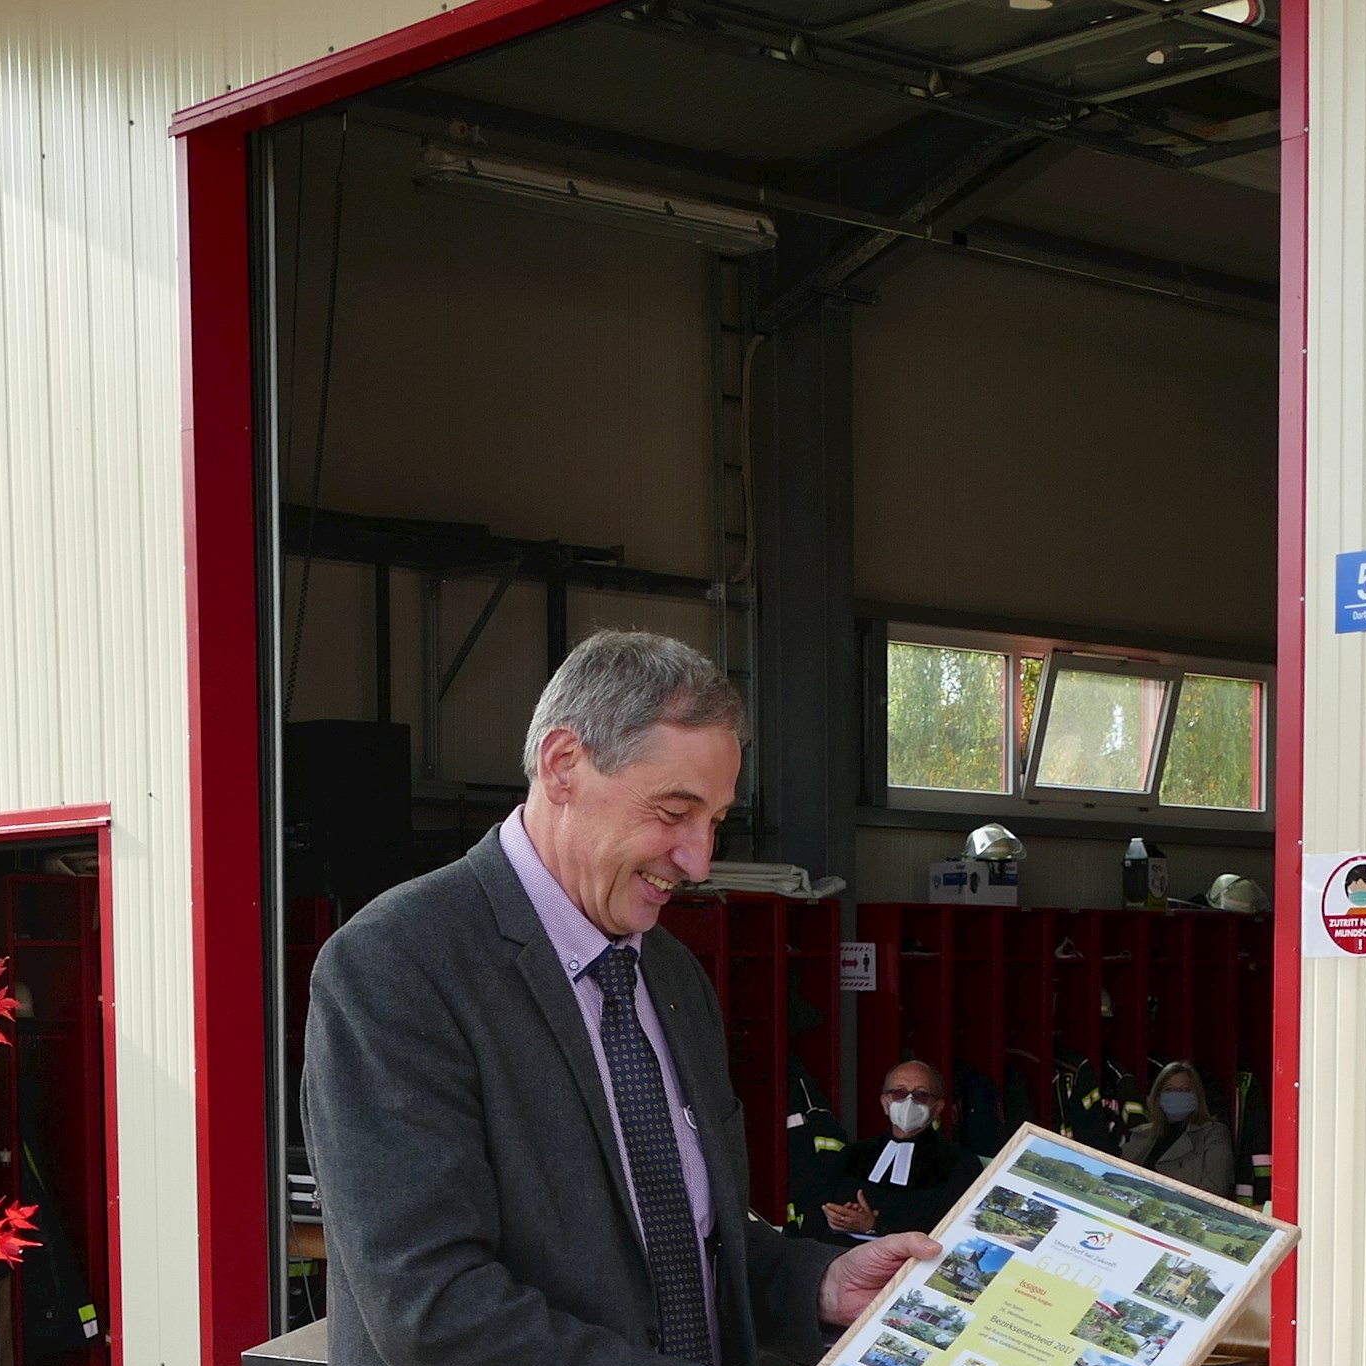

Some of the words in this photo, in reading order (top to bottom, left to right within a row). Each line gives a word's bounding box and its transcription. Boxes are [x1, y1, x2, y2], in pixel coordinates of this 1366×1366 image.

[1329, 919, 1358, 927] ZUTRITT
[1071, 1246, 1084, 1255] Dorf
[1037, 1255, 1103, 1289] GOLD
[1019, 1280, 1047, 1296] Issigau
[990, 1315, 1055, 1347] Bezirksentscheid
[1053, 1342, 1076, 1355] 2017
